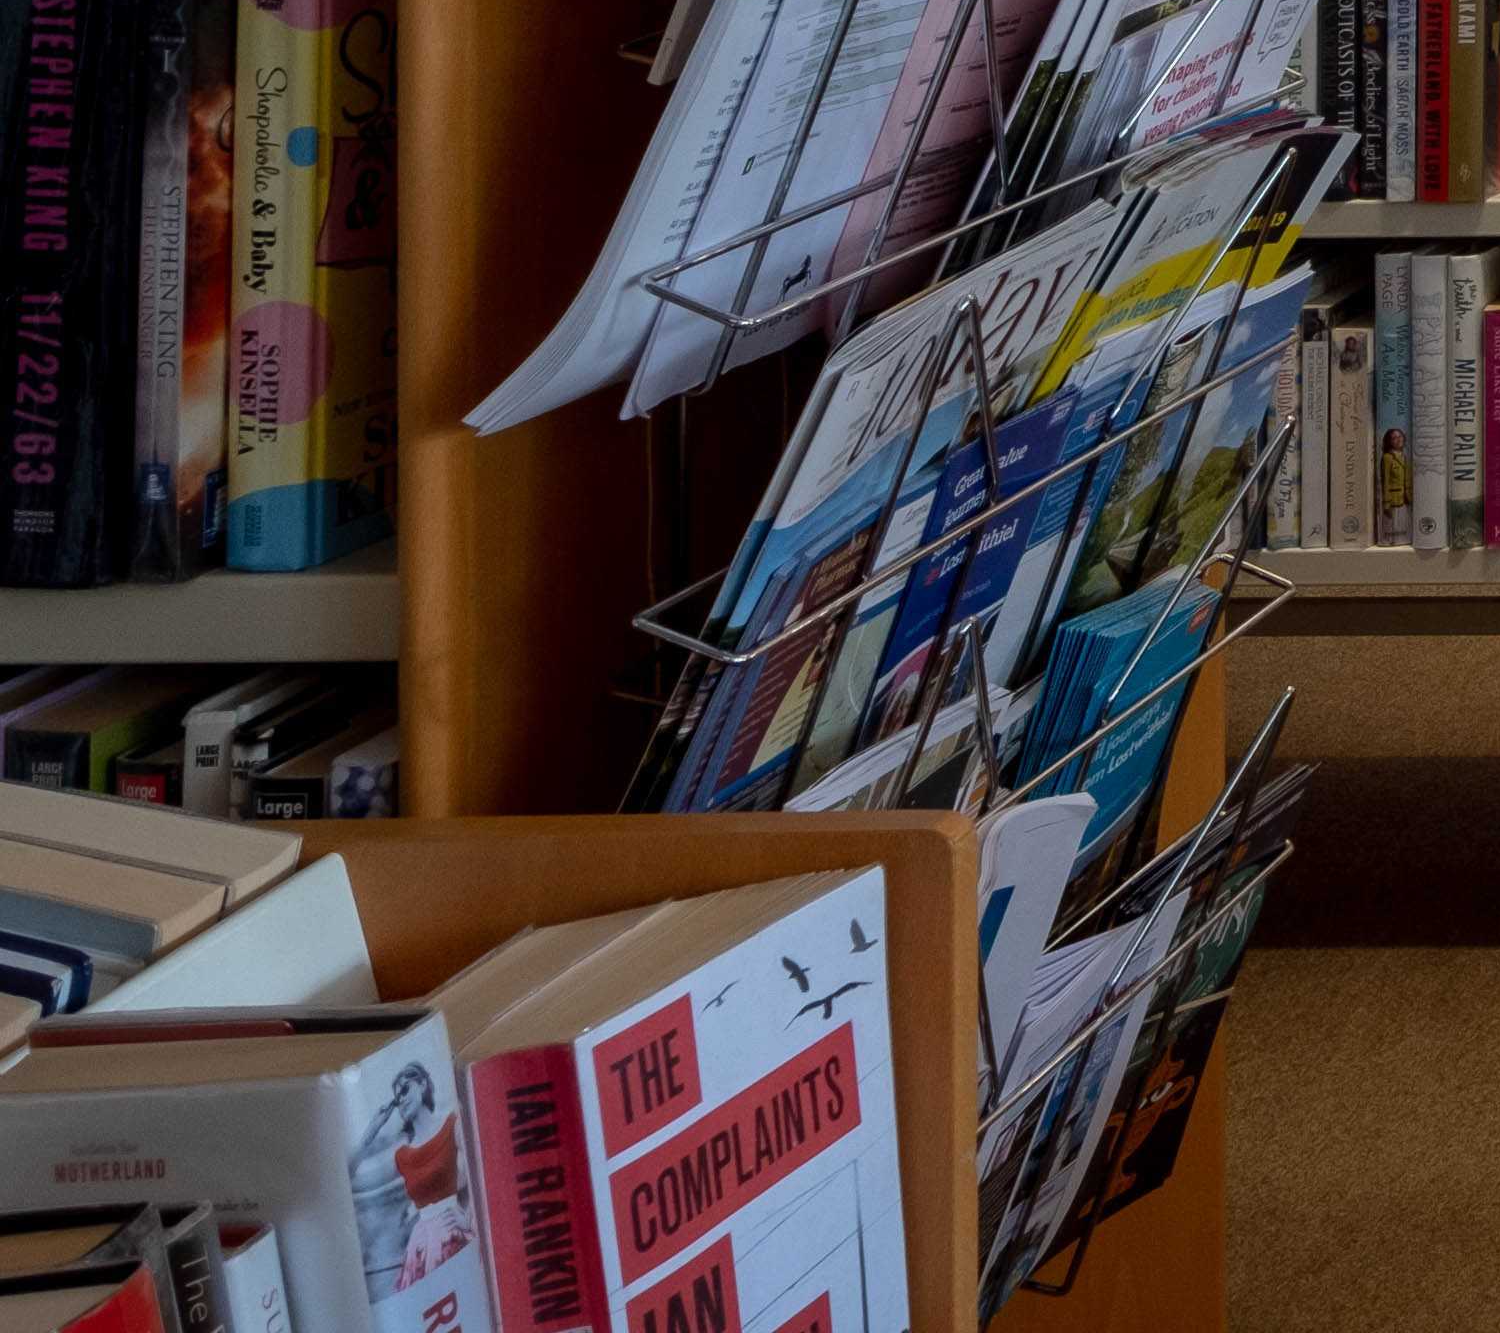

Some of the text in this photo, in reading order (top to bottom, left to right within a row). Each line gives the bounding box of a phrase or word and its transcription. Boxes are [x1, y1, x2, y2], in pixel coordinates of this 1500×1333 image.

[22, 165, 71, 254] KING
[242, 66, 290, 296] Shopaholic & Baby
[156, 184, 184, 381] STEPHEN KING
[12, 293, 64, 486] 11/22/63
[237, 327, 259, 458] KINSELLA
[256, 343, 282, 444] SOPHIE
[1453, 358, 1477, 483] MICHAEL PALIN
[256, 796, 305, 819] Large
[607, 1029, 689, 1106] THE
[505, 1079, 582, 1325] IAN RANKIN
[628, 1052, 849, 1255] COMPLAINTS
